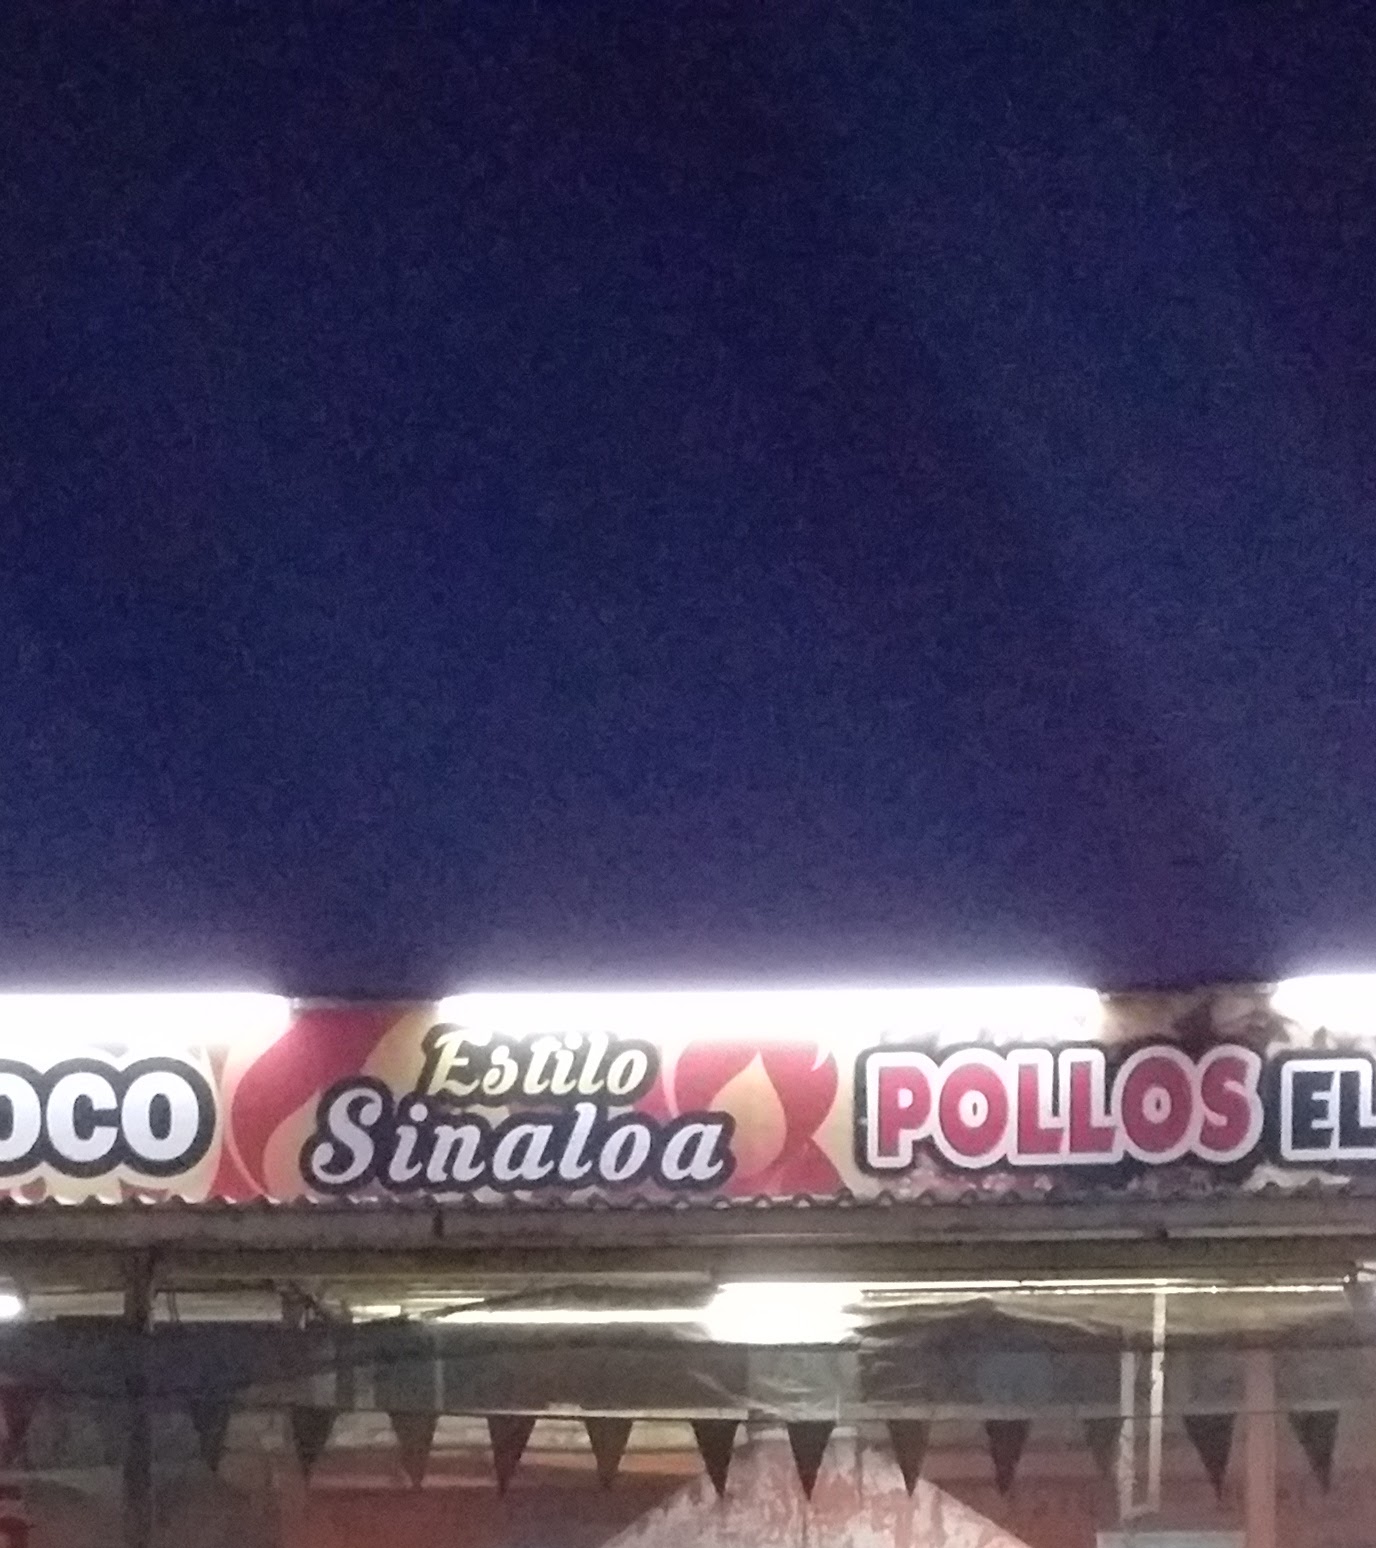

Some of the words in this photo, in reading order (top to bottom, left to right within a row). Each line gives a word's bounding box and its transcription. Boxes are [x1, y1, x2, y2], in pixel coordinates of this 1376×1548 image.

[427, 1027, 648, 1097] Estilo
[866, 1044, 1265, 1169] POLLOS
[311, 1084, 724, 1186] Sinaloa
